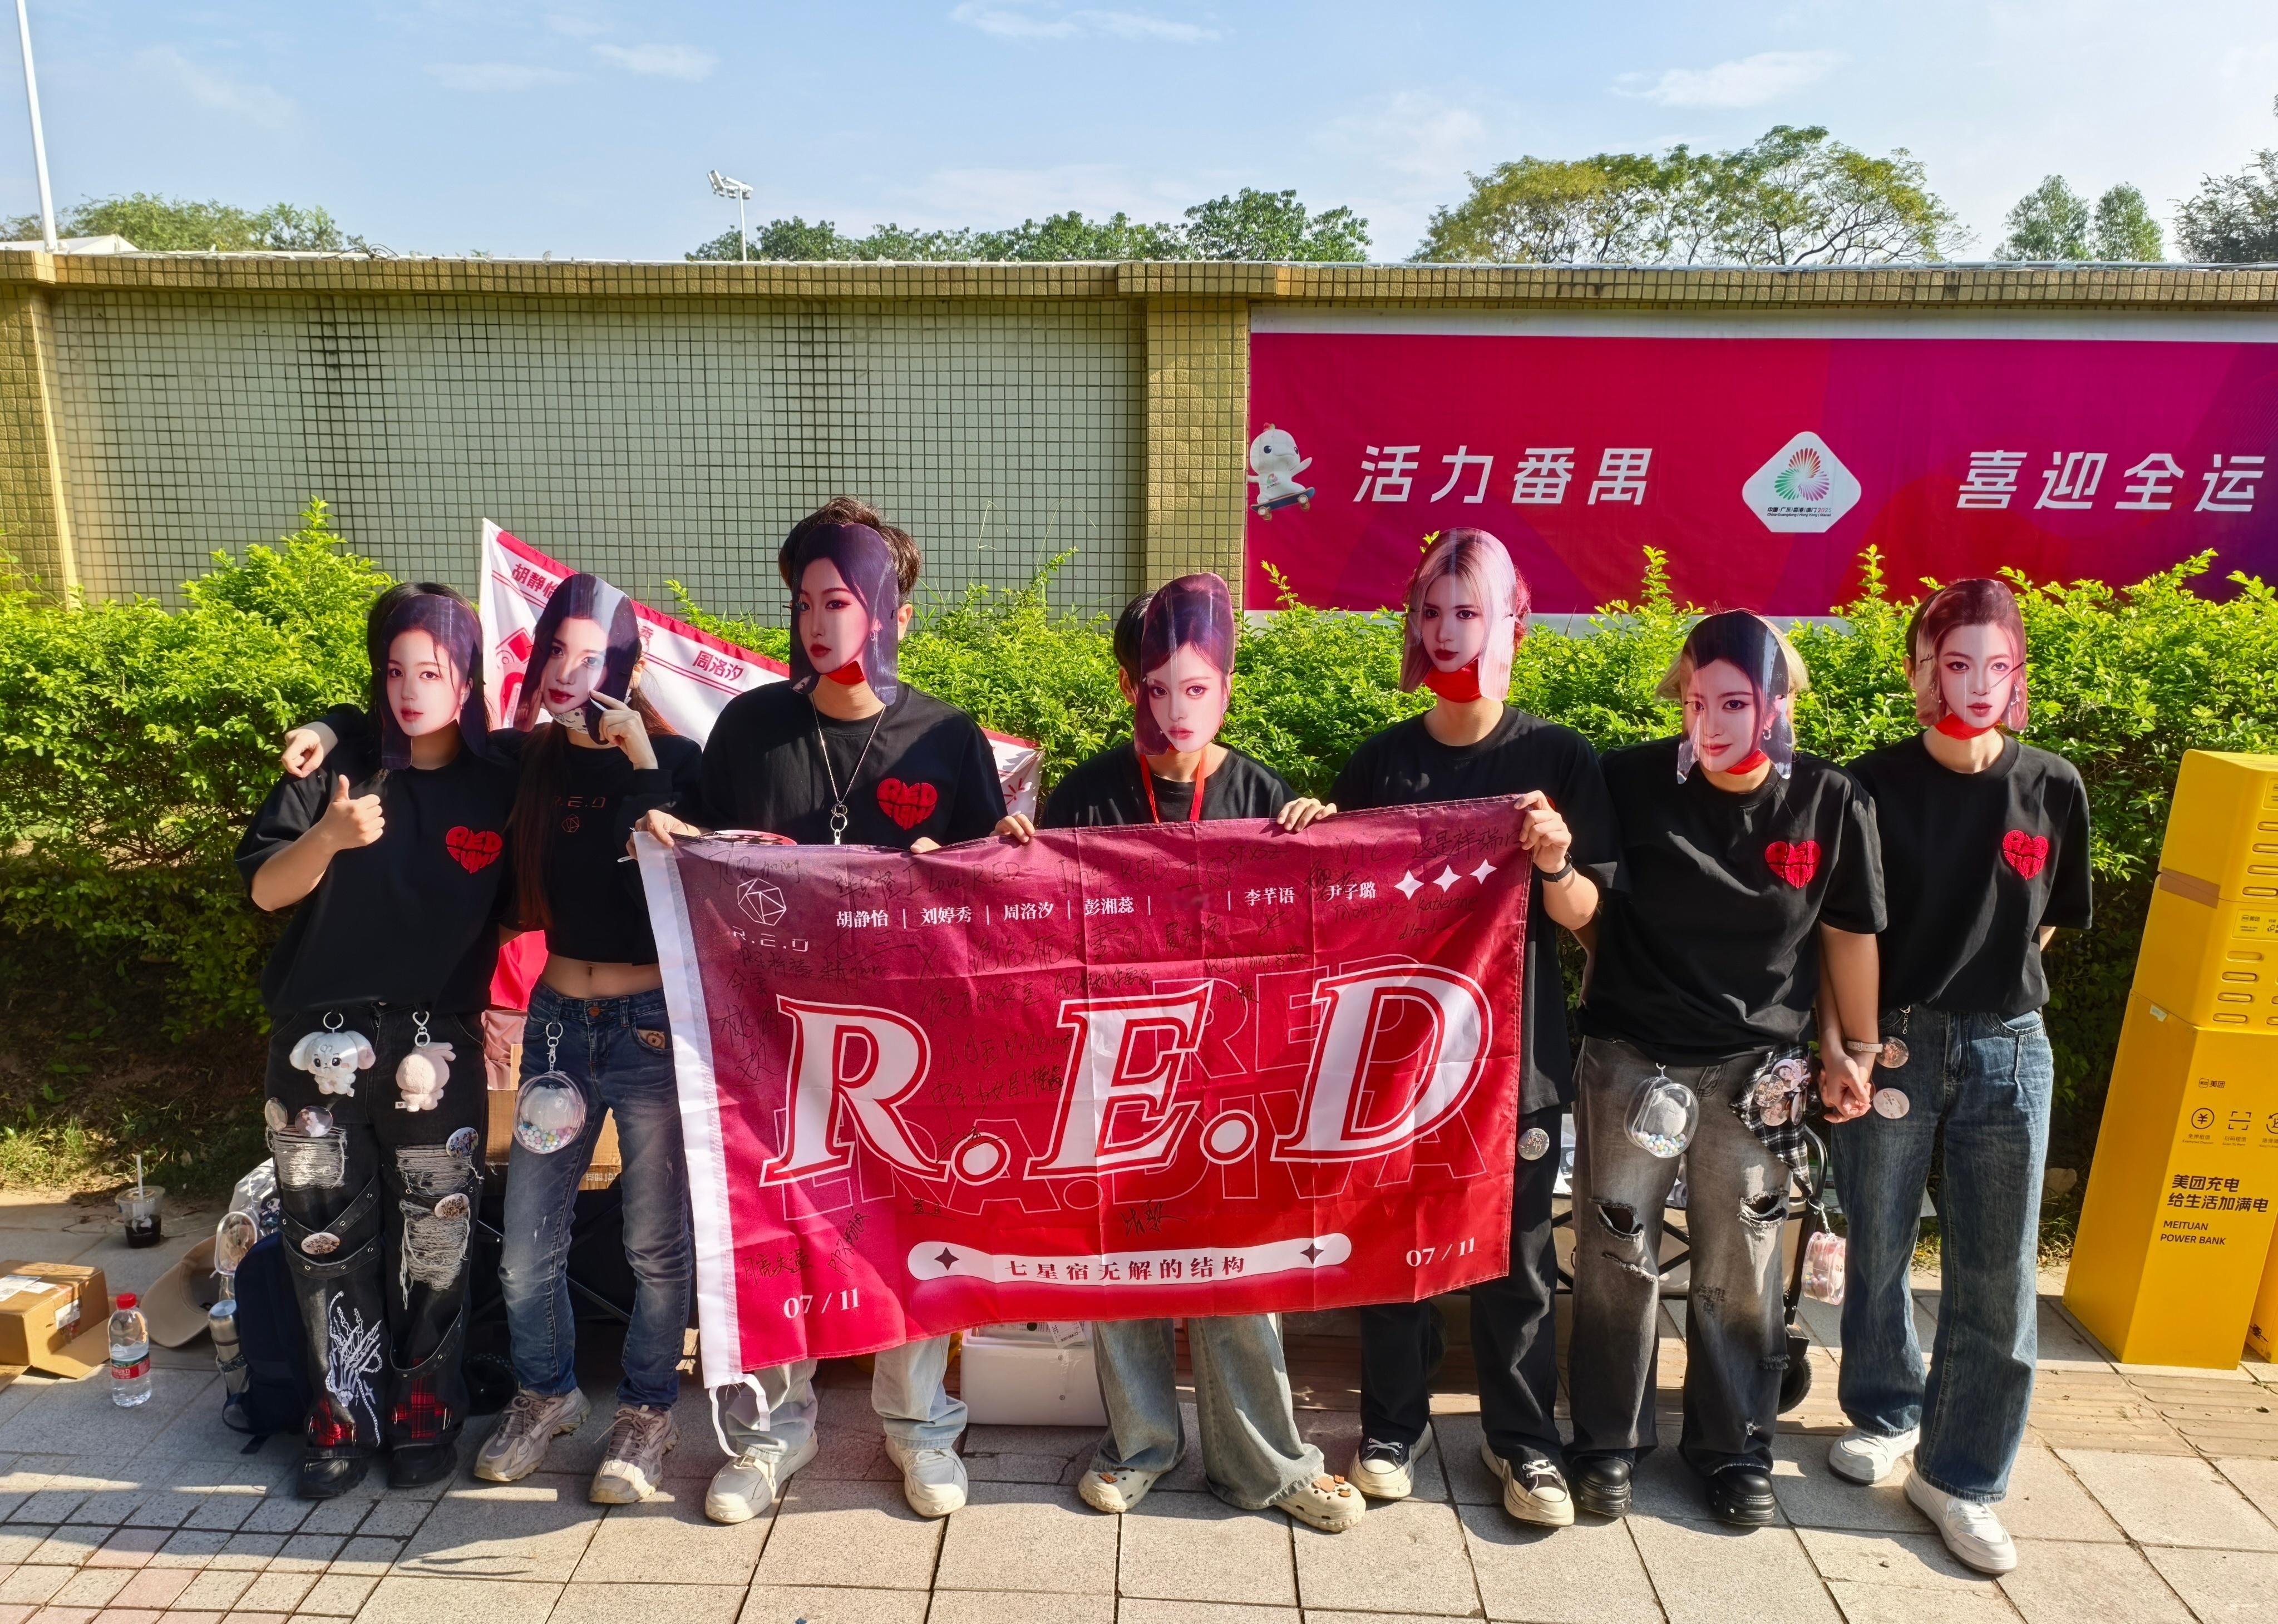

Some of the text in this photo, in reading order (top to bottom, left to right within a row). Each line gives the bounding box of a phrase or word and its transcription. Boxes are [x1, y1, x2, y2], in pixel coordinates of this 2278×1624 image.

[1353, 445, 1653, 505] 活力番禺
[1956, 450, 2266, 512] 喜迎全运
[692, 650, 744, 681] 周洛汐
[876, 778, 938, 808] RED
[446, 826, 503, 854] RED
[1765, 840, 1821, 864] RED
[836, 881, 1376, 929] 胡静怡 刘婷秀 周洛汐 彭湘蕊 李芊语 尹子璐
[760, 962, 1492, 1187] R.E.D
[2172, 1174, 2240, 1192] 美团充电
[2167, 1192, 2269, 1212] 给生活加满电
[2160, 1233, 2226, 1245] POWER BANK
[2163, 1220, 2208, 1231] MEITUAN
[1004, 1256, 1245, 1281] 七星宿无解的结构
